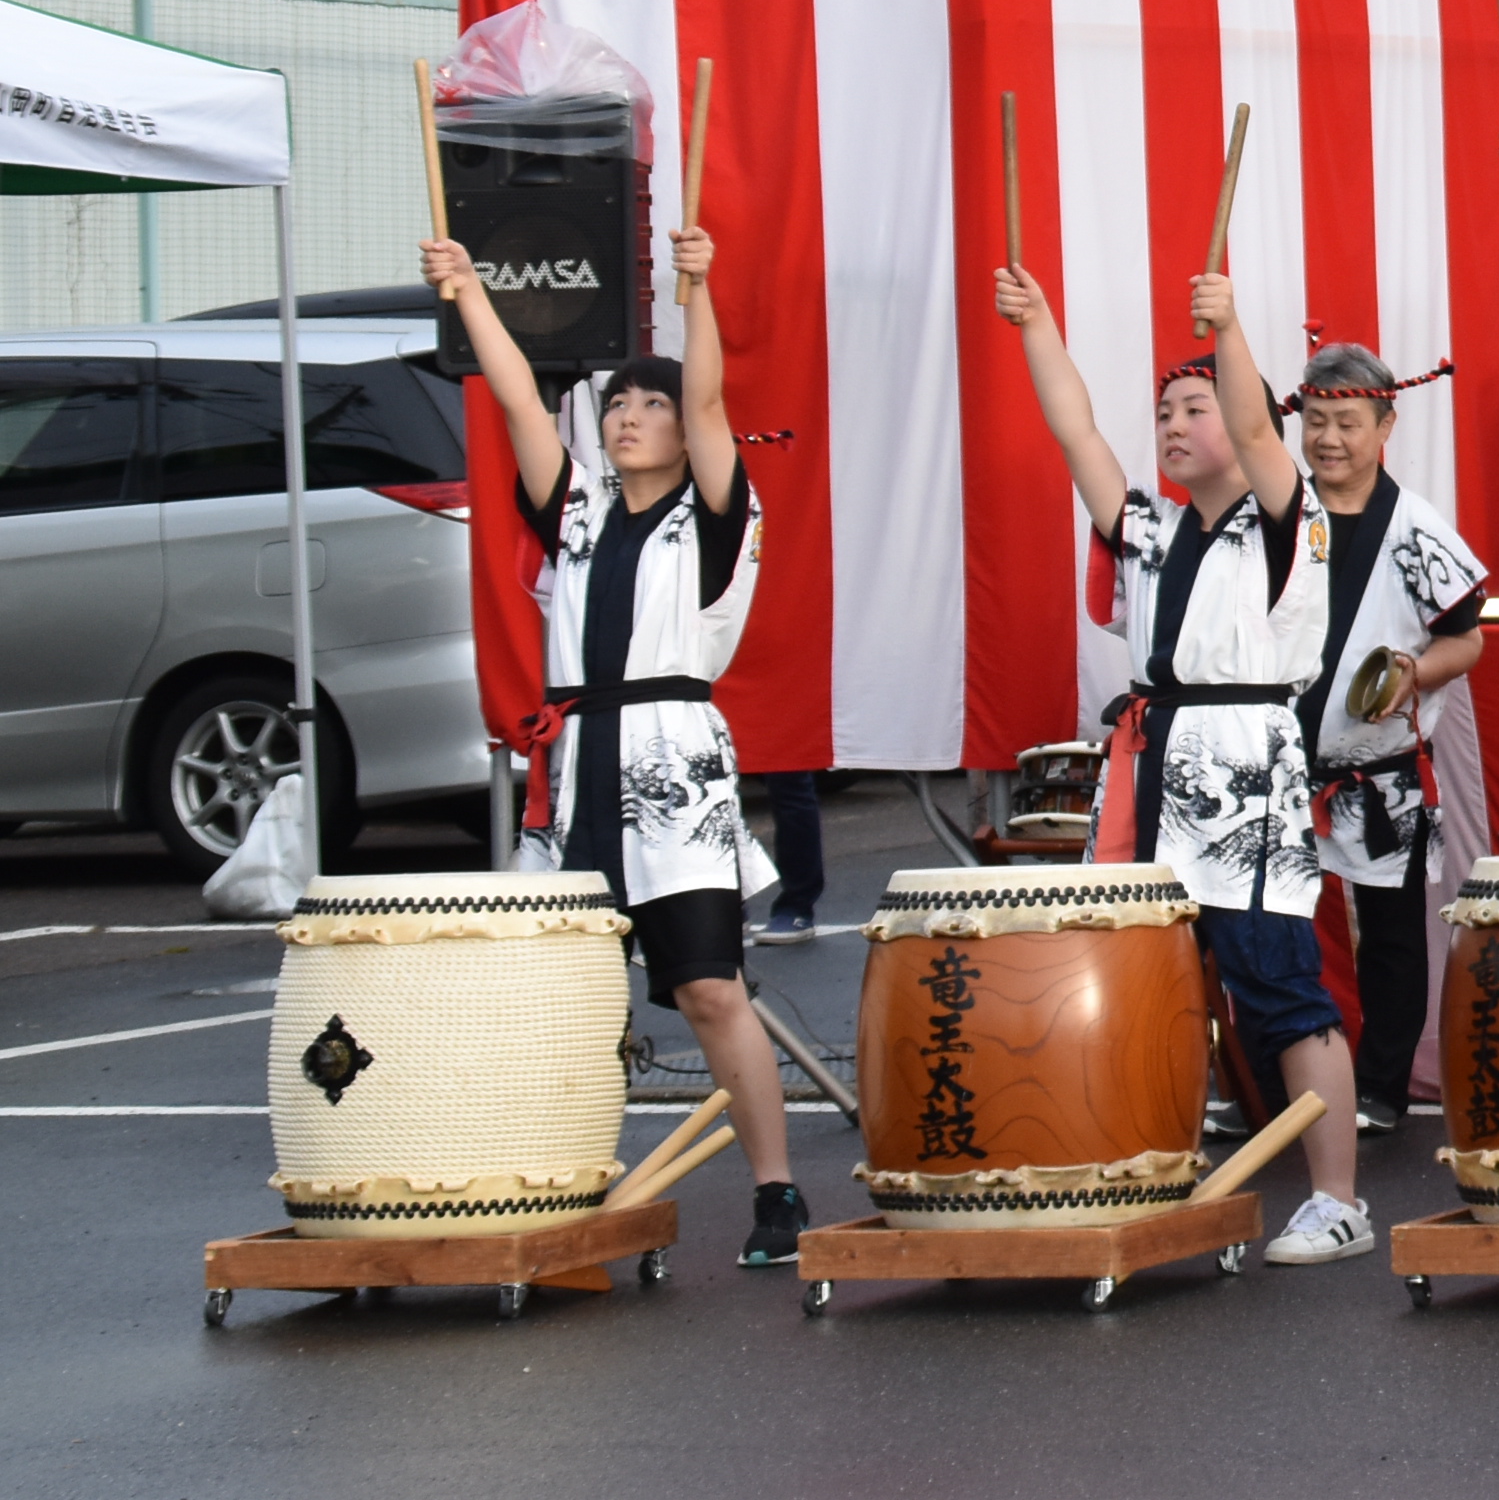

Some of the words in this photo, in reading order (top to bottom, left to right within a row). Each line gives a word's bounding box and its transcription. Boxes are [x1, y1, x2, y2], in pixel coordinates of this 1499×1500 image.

[0, 86, 158, 136] 岡町自治連合会
[473, 259, 601, 291] RAMSA
[914, 946, 988, 1162] 竜王太鼓
